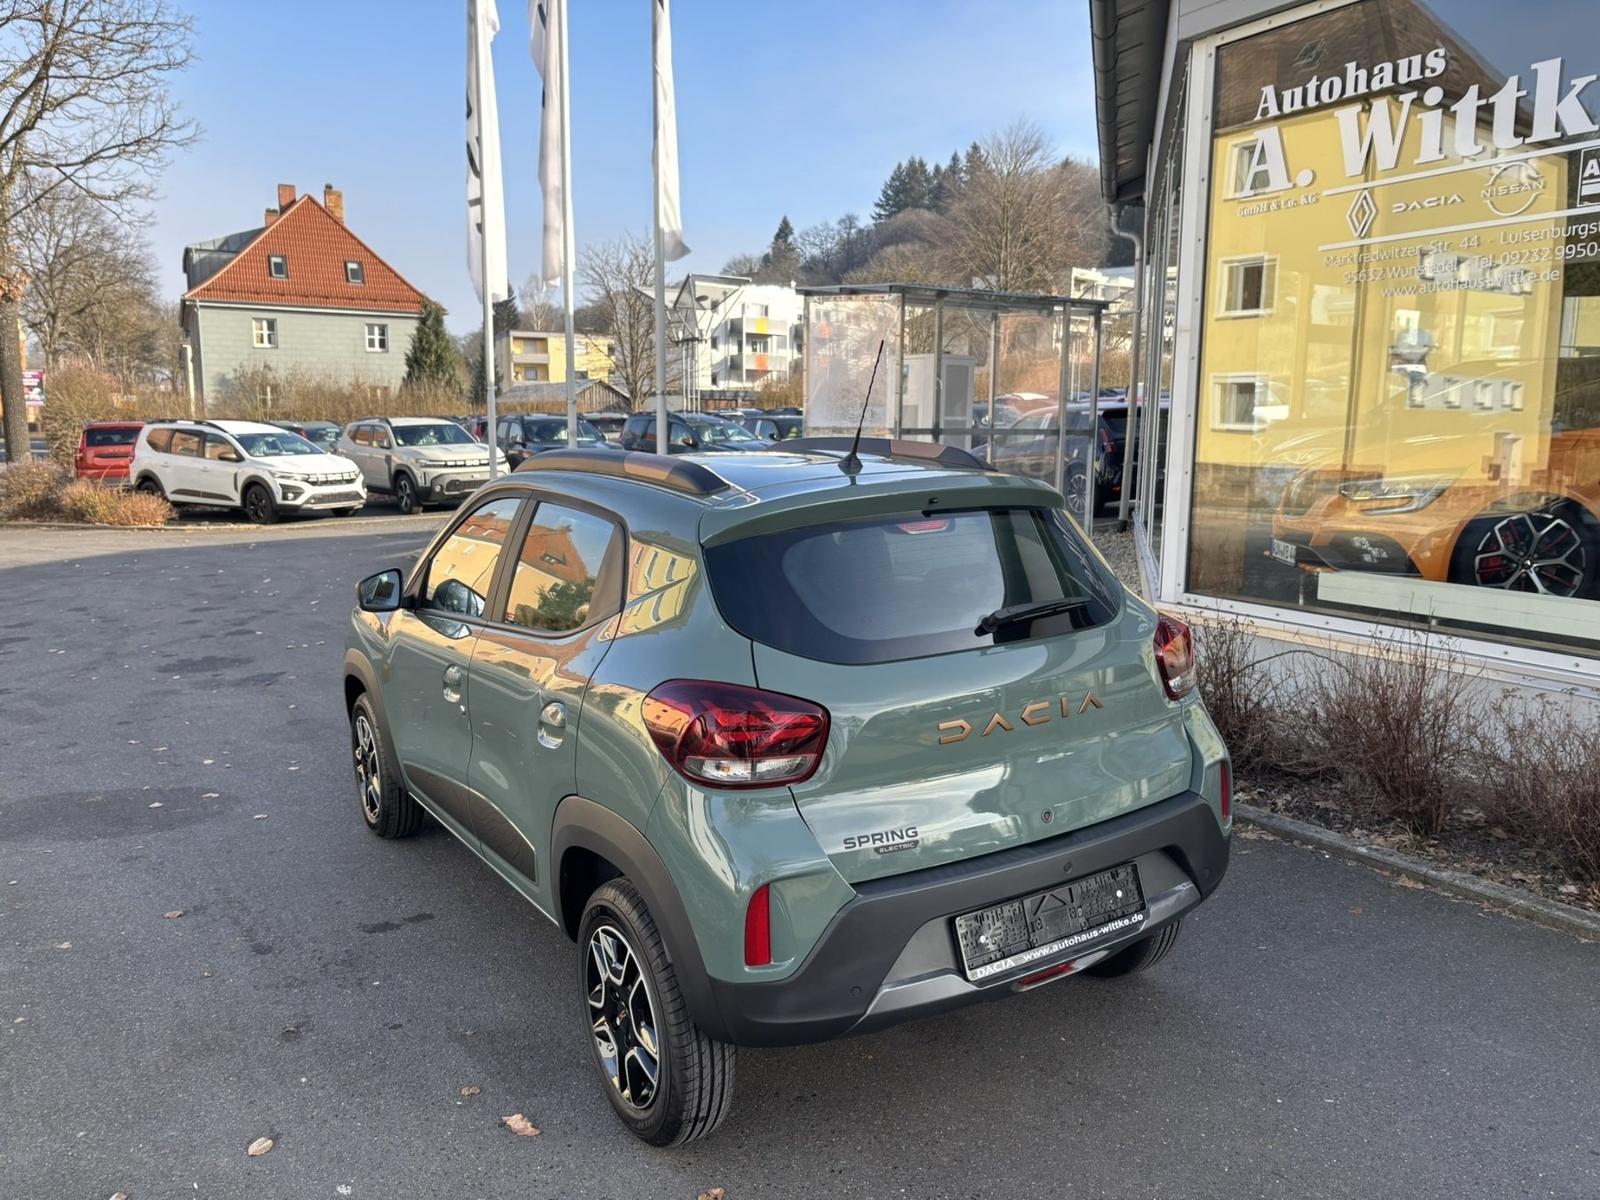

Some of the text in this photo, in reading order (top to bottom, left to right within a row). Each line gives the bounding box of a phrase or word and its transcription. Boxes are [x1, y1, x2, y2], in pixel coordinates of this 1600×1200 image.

[1254, 48, 1446, 121] Autohaus
[1239, 57, 1600, 199] A. Wittk
[1481, 180, 1545, 199] NISSAN
[1237, 200, 1268, 217] GmbH
[1269, 200, 1279, 211] &
[1392, 194, 1463, 213] DACIA
[1459, 234, 1480, 249] 44
[1501, 246, 1552, 266] 09232
[937, 690, 1104, 744] DACIA
[843, 826, 919, 850] SPRING
[879, 841, 916, 853] ELECTRIC
[976, 912, 1144, 979] DACIA www.autohaus-wittke.de
